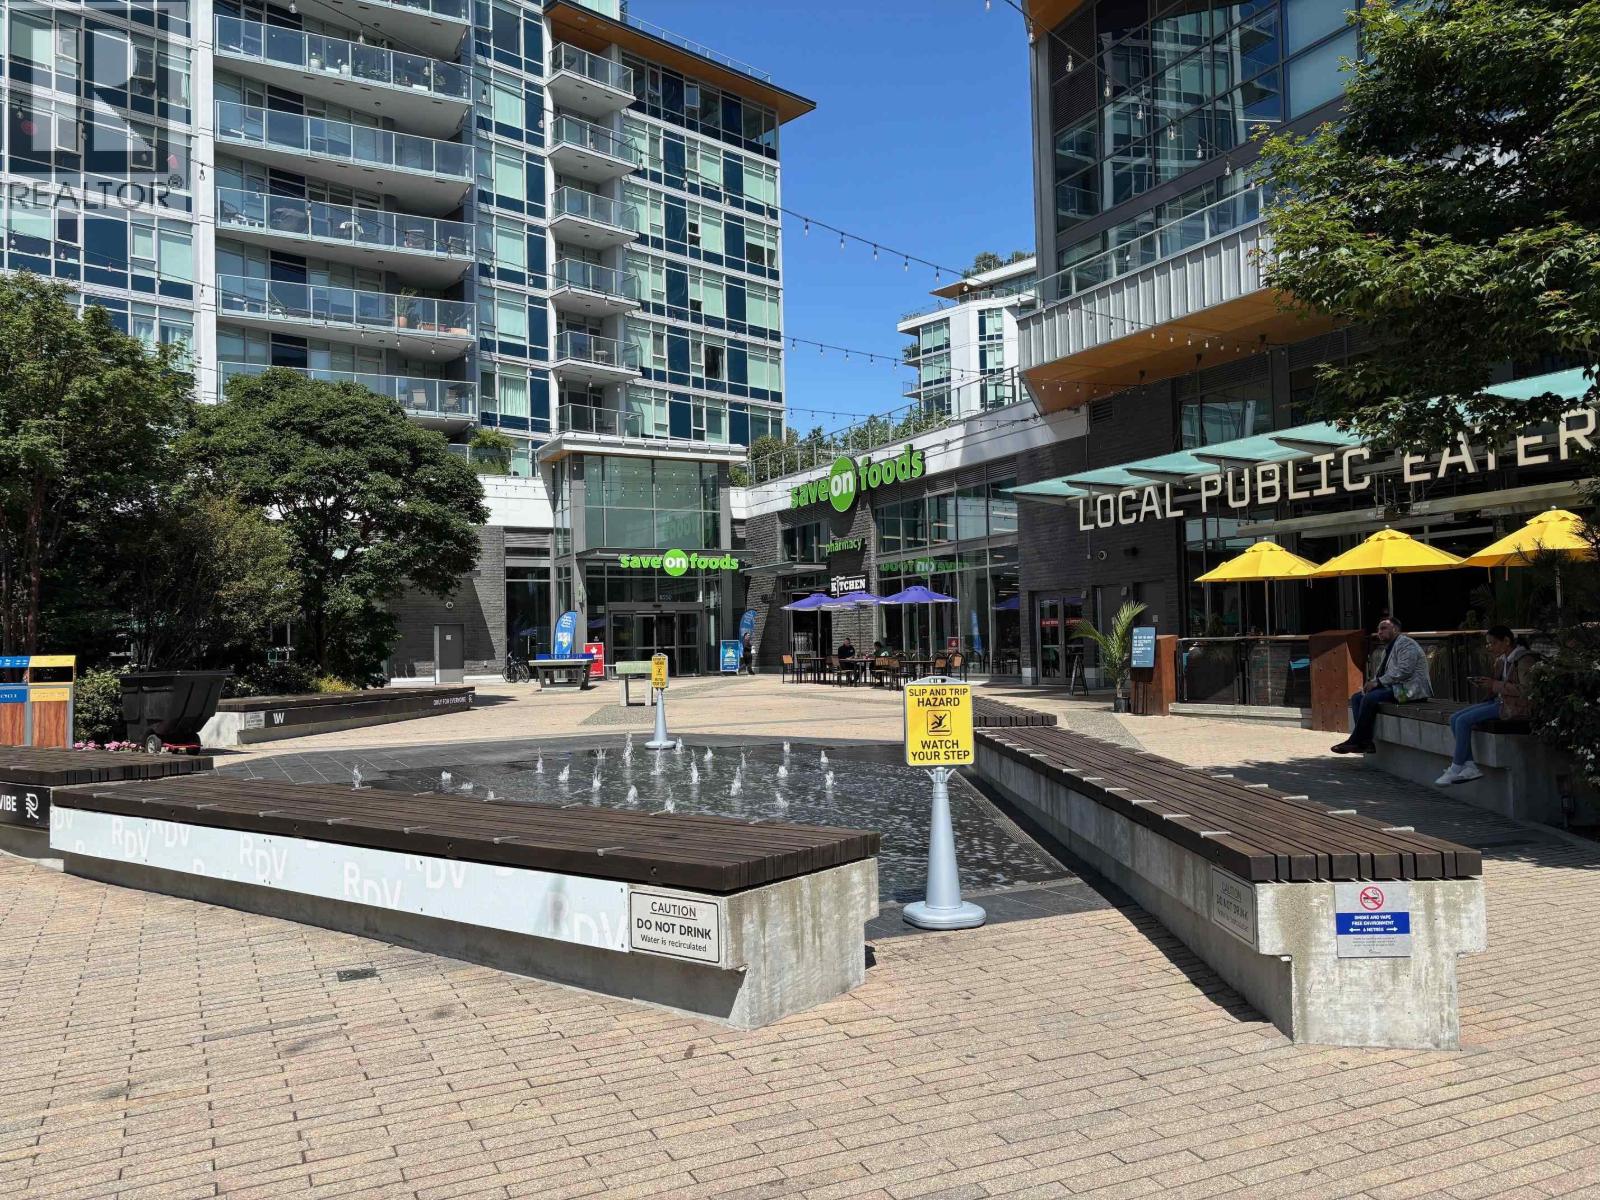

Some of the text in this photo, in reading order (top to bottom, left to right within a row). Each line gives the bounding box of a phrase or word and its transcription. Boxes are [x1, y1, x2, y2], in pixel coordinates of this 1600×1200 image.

[790, 444, 925, 509] save on foods
[1079, 482, 1184, 532] LOCAL
[1200, 446, 1372, 513] PUBLIC
[825, 538, 862, 556] pharmacy
[618, 552, 739, 570] save on foods
[831, 577, 866, 594] KITCHEN
[908, 688, 968, 697] SLIP AND TRIP
[917, 697, 960, 707] HAZARD
[921, 739, 959, 750] WATCH
[911, 750, 970, 761] YOUR STEP
[651, 901, 696, 917] CAUTION
[637, 918, 712, 940] DO NOT DRINK
[640, 934, 707, 952] Water is recirculated
